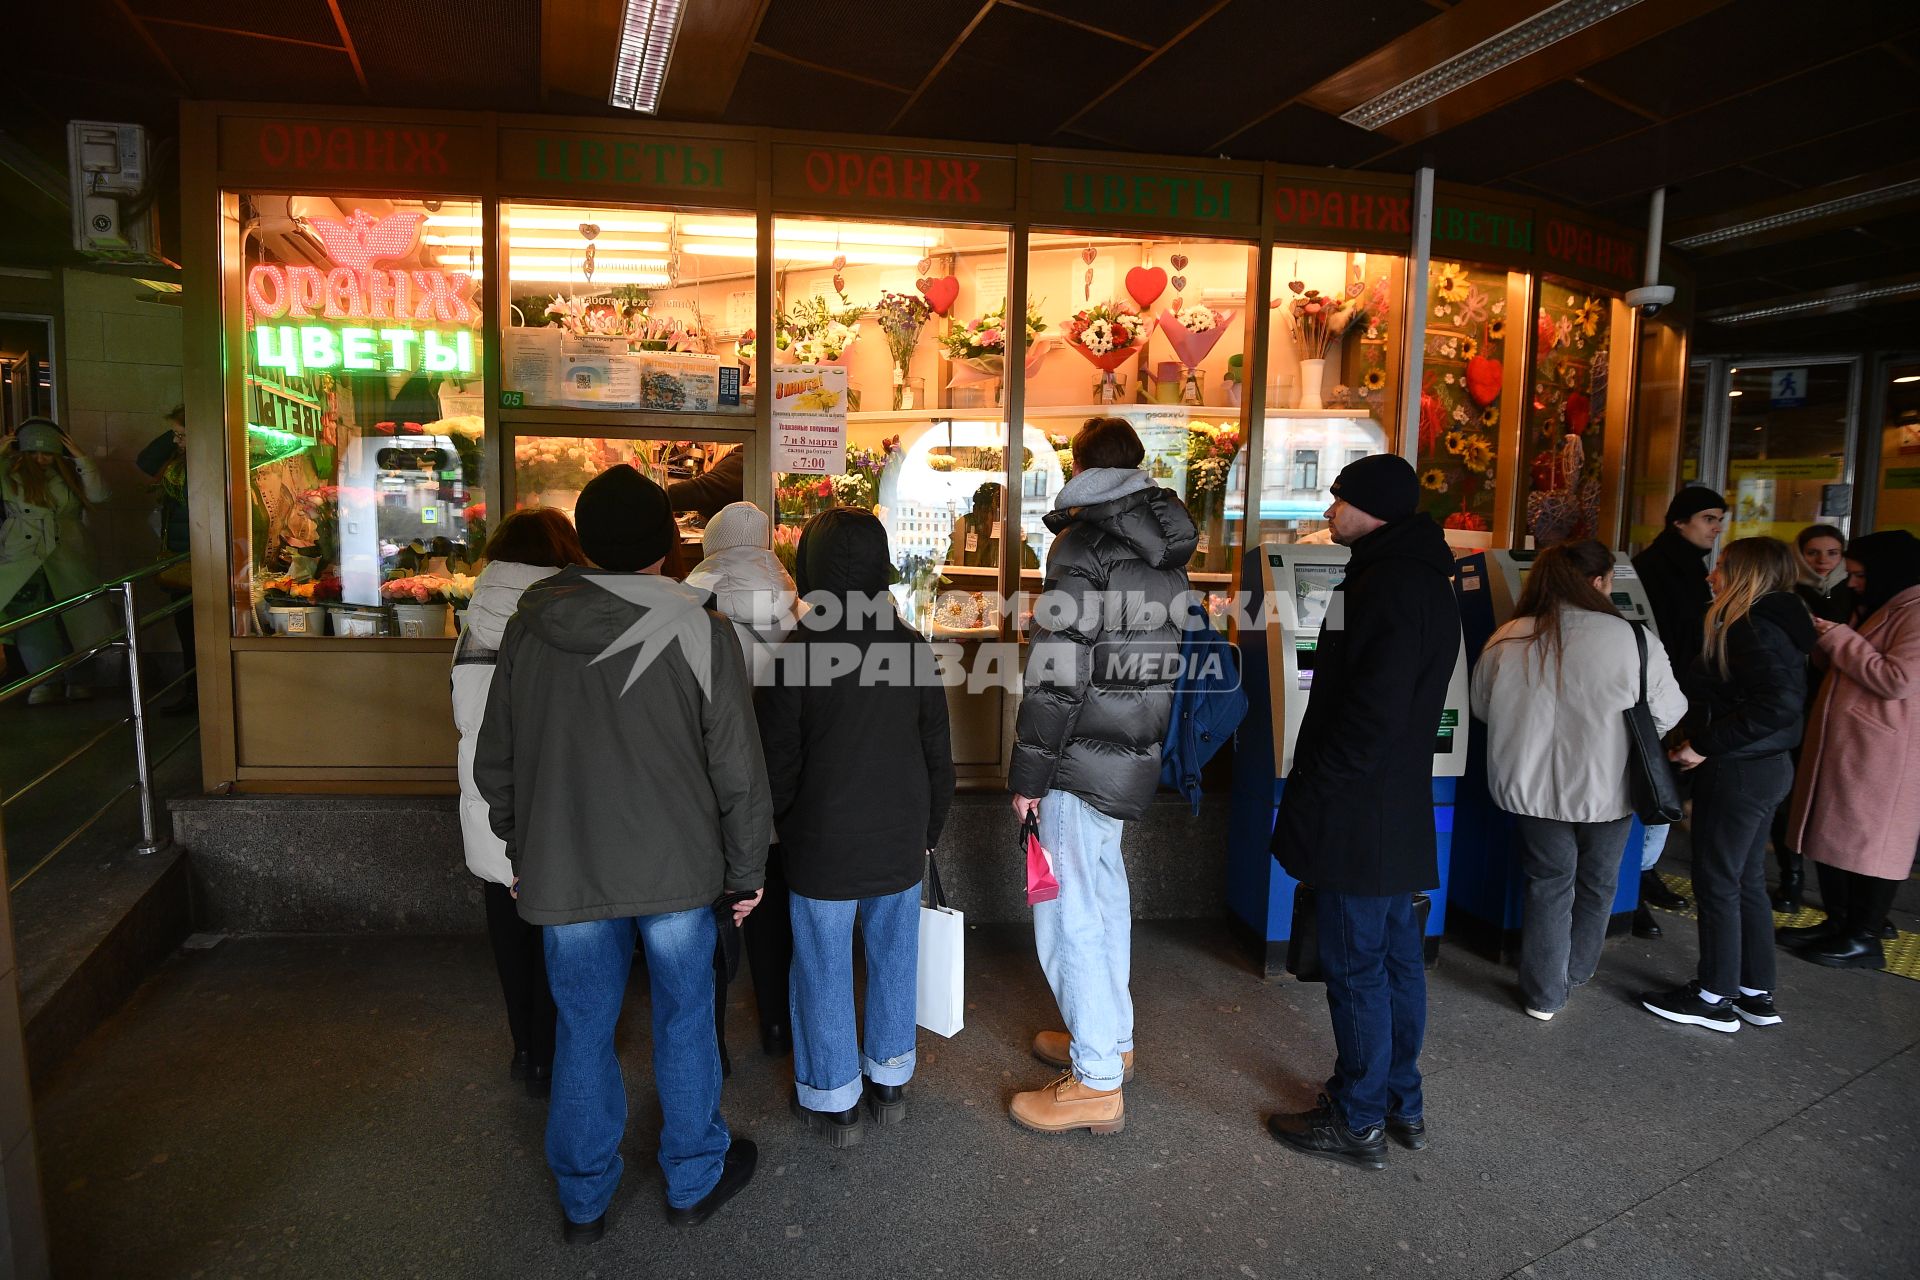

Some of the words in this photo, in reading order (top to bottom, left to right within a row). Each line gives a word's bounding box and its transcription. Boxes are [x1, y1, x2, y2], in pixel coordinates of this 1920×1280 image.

[259, 123, 449, 176] ОРАНЖ
[536, 138, 726, 188] ЦВЕТЫ
[805, 151, 983, 204] ОРАНЖ
[1062, 172, 1230, 219] ЦВЕТЫ
[1275, 186, 1412, 234] ОРАНЖ
[1545, 216, 1635, 278] ОРАНЖ
[248, 264, 472, 322] ОРАНЖ
[256, 327, 474, 377] ЦВЕТЫ
[503, 393, 521, 406] 05
[784, 435, 789, 444] 7
[800, 436, 806, 445] 8
[808, 438, 838, 447] марта
[800, 457, 825, 468] 7:00
